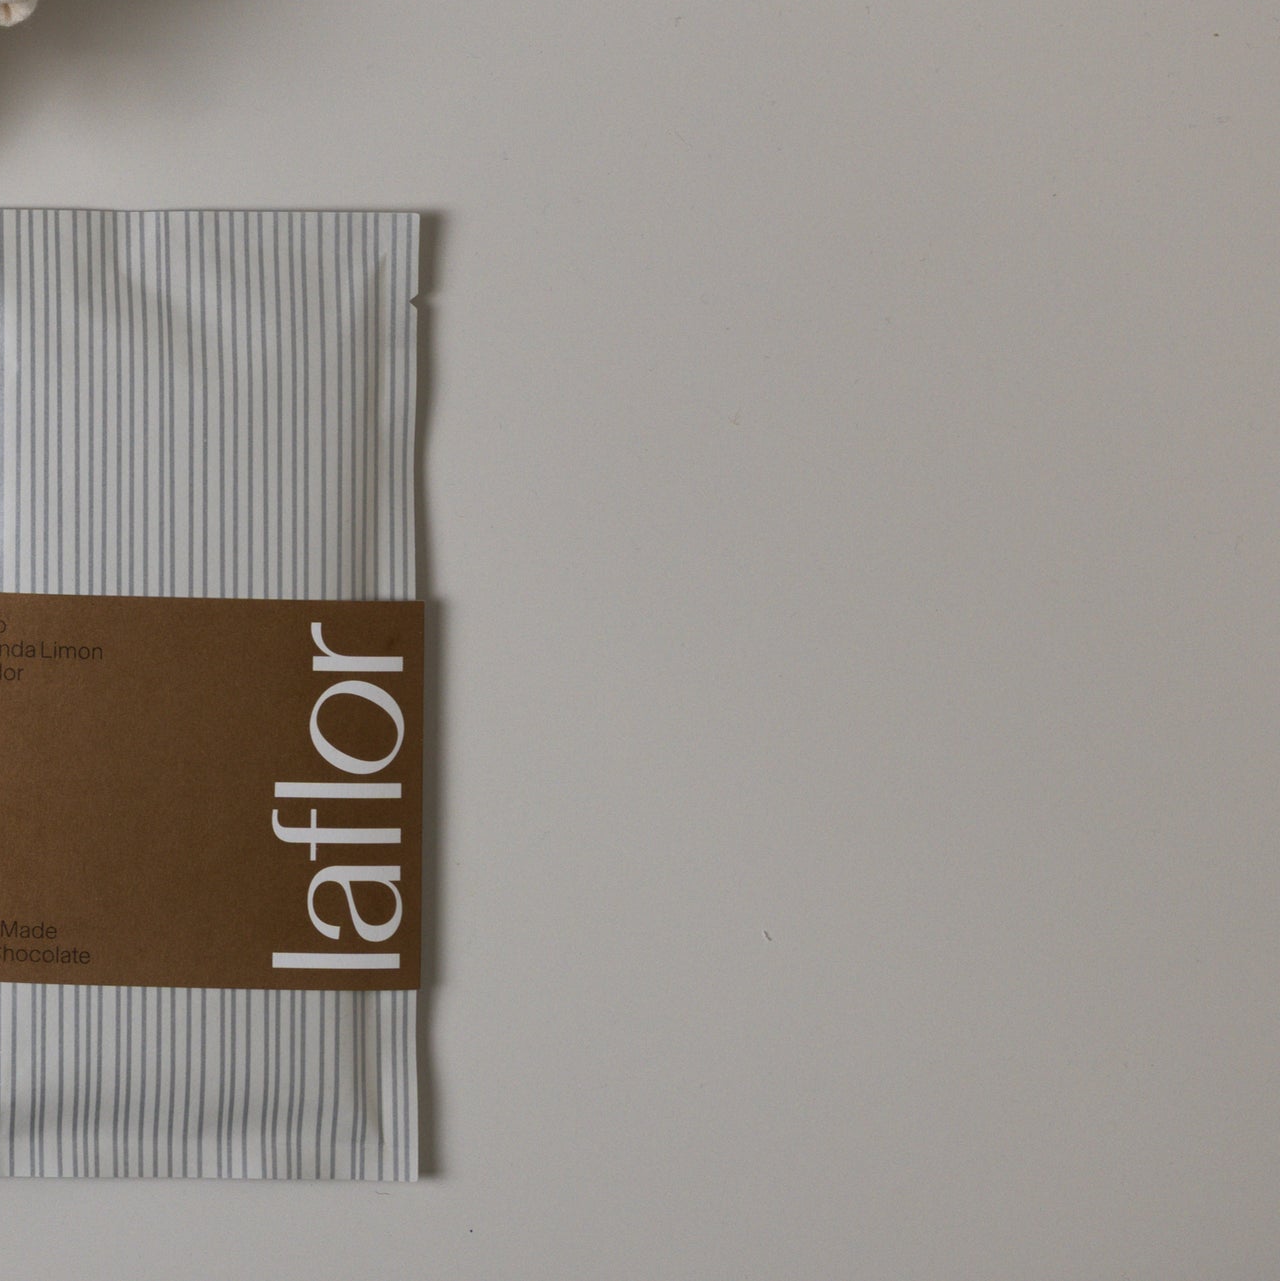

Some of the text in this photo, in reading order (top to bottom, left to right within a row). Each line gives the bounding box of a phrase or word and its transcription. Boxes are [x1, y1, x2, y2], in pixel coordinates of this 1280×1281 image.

[41, 640, 104, 661] Limon
[271, 621, 405, 970] laflor
[0, 920, 58, 941] Made
